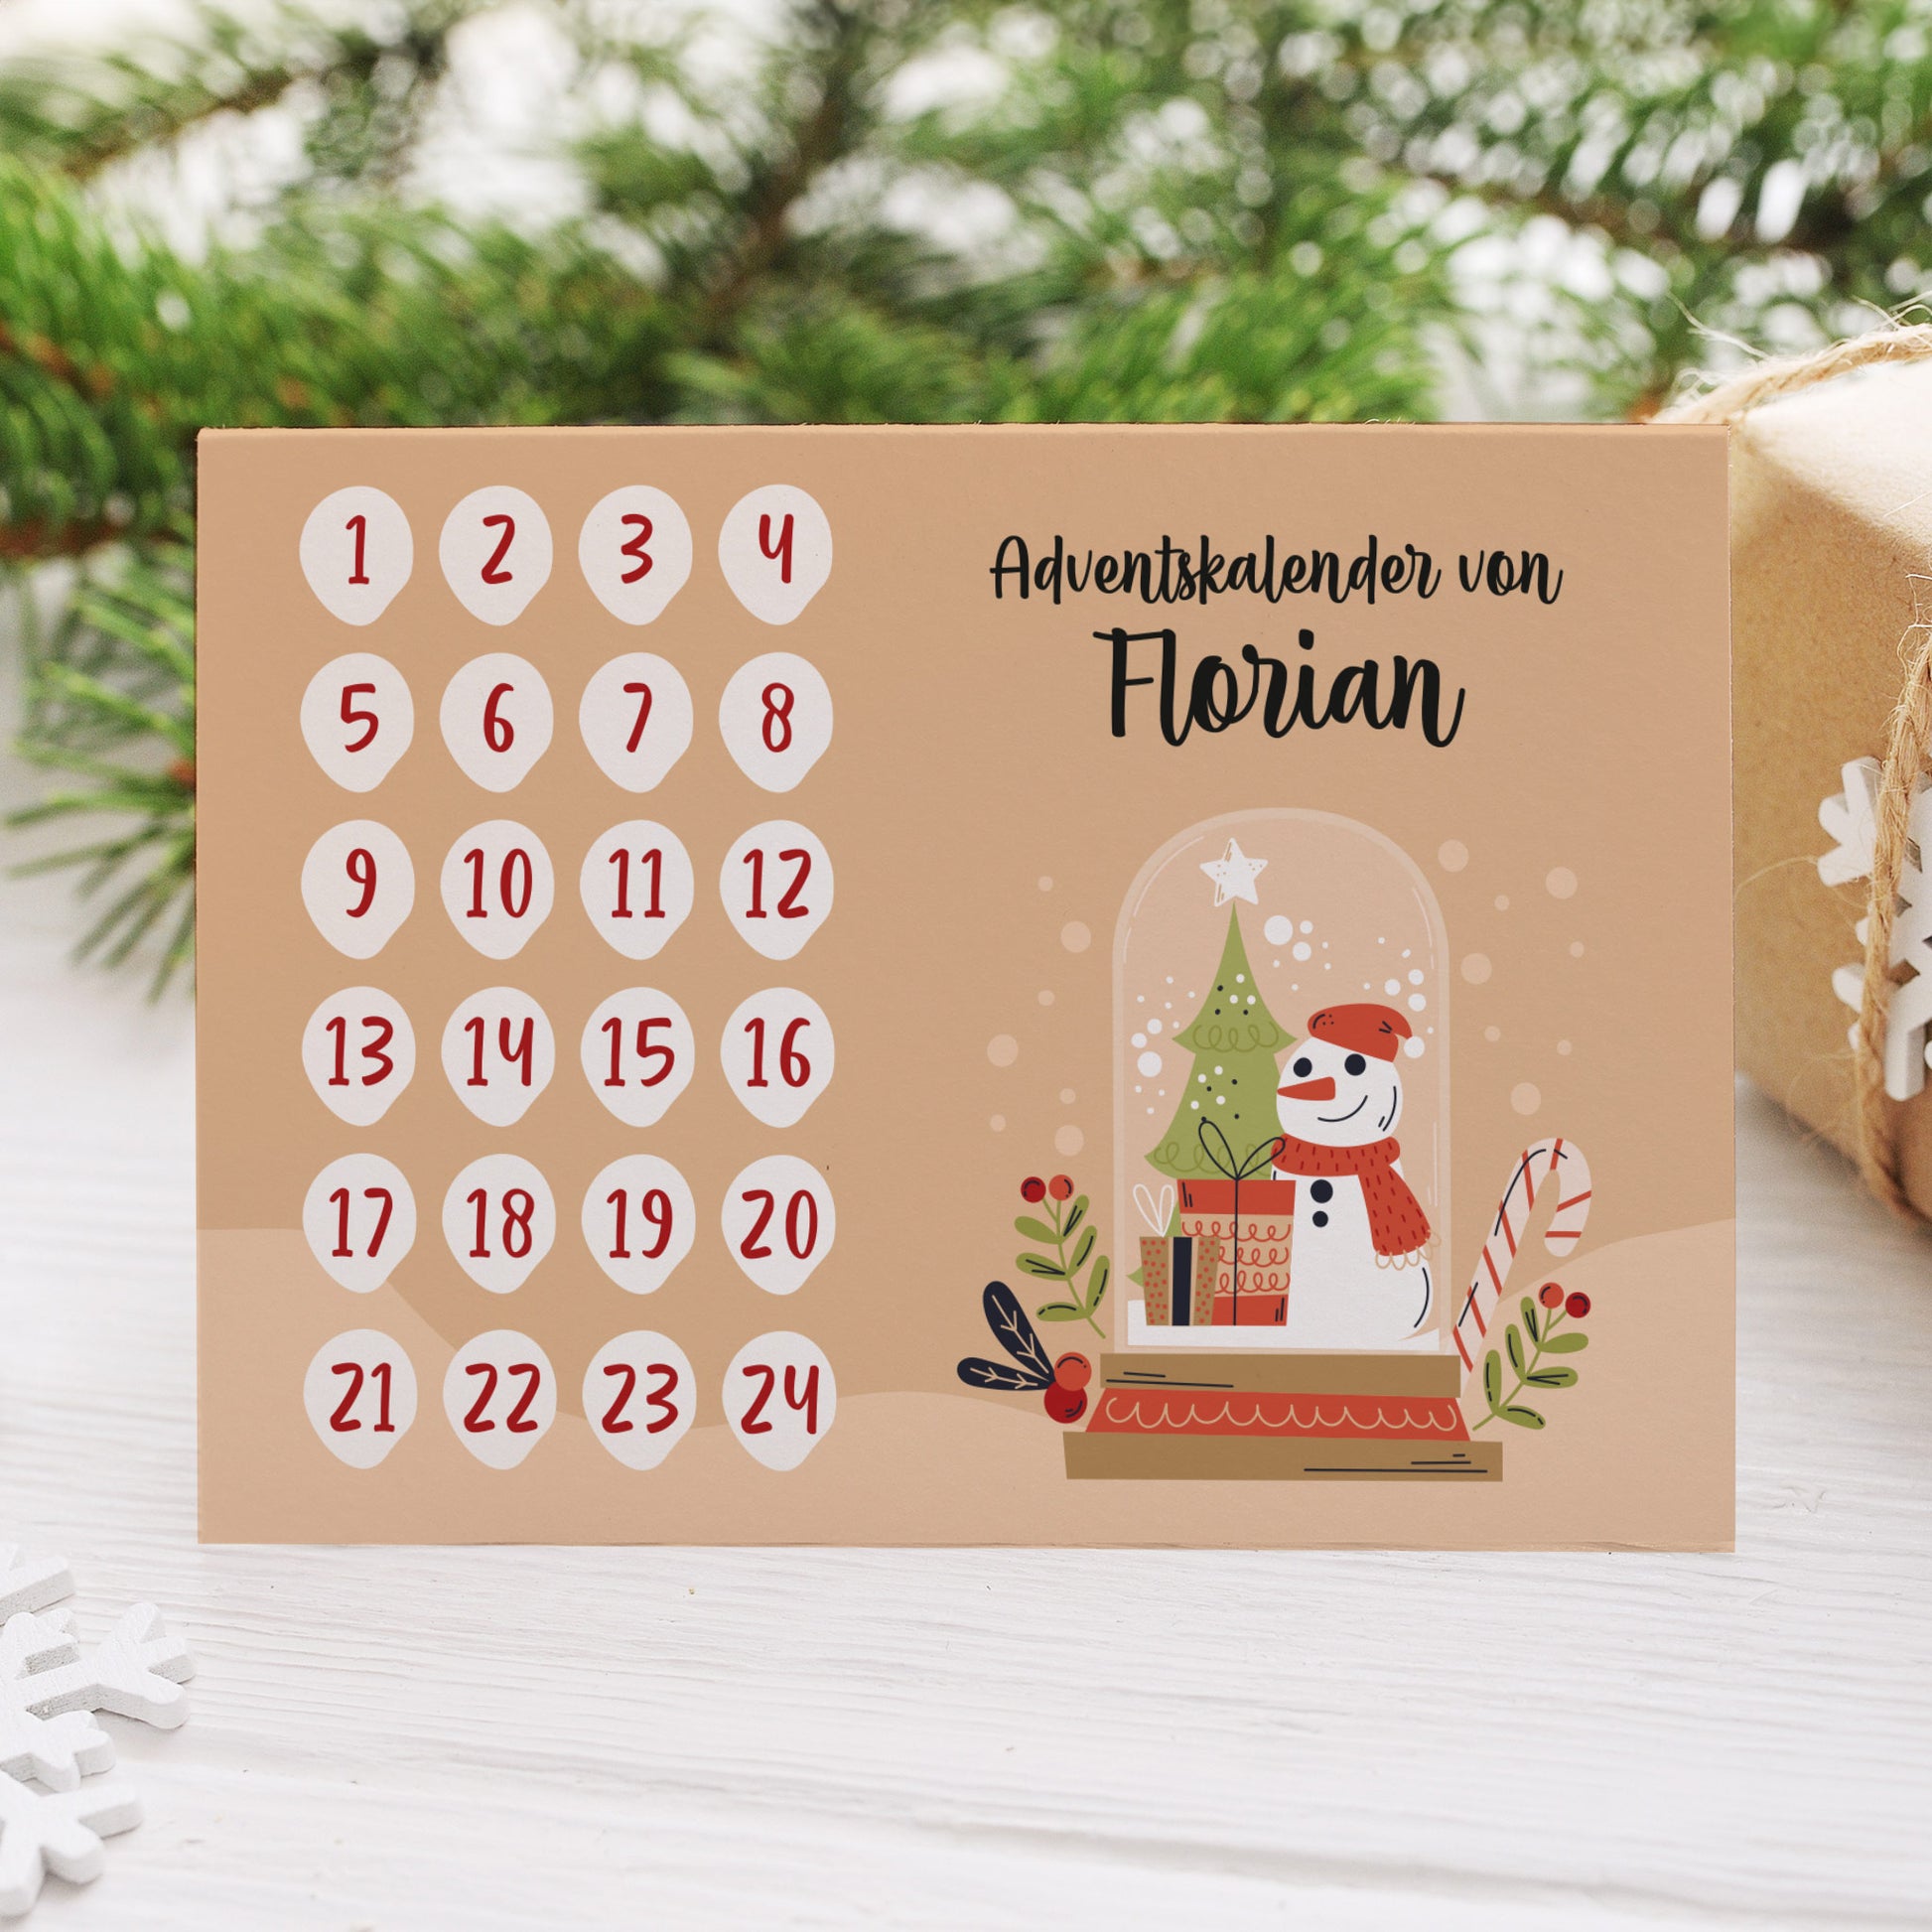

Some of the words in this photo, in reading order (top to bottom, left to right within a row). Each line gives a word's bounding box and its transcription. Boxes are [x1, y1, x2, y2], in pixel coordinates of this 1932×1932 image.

[346, 515, 369, 584] 1
[482, 514, 514, 584] 2
[621, 514, 652, 584] 3
[759, 514, 793, 583] 4
[989, 534, 1442, 606] Adventskalender
[1458, 550, 1564, 605] von
[341, 683, 378, 753] 5
[484, 683, 513, 753] 6
[623, 683, 651, 753] 7
[762, 683, 794, 753] 8
[1092, 626, 1466, 749] Florian
[346, 849, 376, 917] 9
[465, 849, 532, 917] 10
[610, 849, 665, 917] 11
[744, 849, 810, 918] 12
[327, 1017, 393, 1085] 13
[465, 1017, 533, 1086] 14
[602, 1018, 674, 1086] 15
[745, 1018, 810, 1087] 16
[330, 1188, 392, 1257] 17
[468, 1189, 534, 1257] 18
[608, 1189, 672, 1258] 19
[741, 1189, 817, 1259] 20
[331, 1363, 394, 1432] 21
[465, 1363, 540, 1433] 22
[602, 1364, 678, 1434] 23
[742, 1365, 818, 1434] 24
